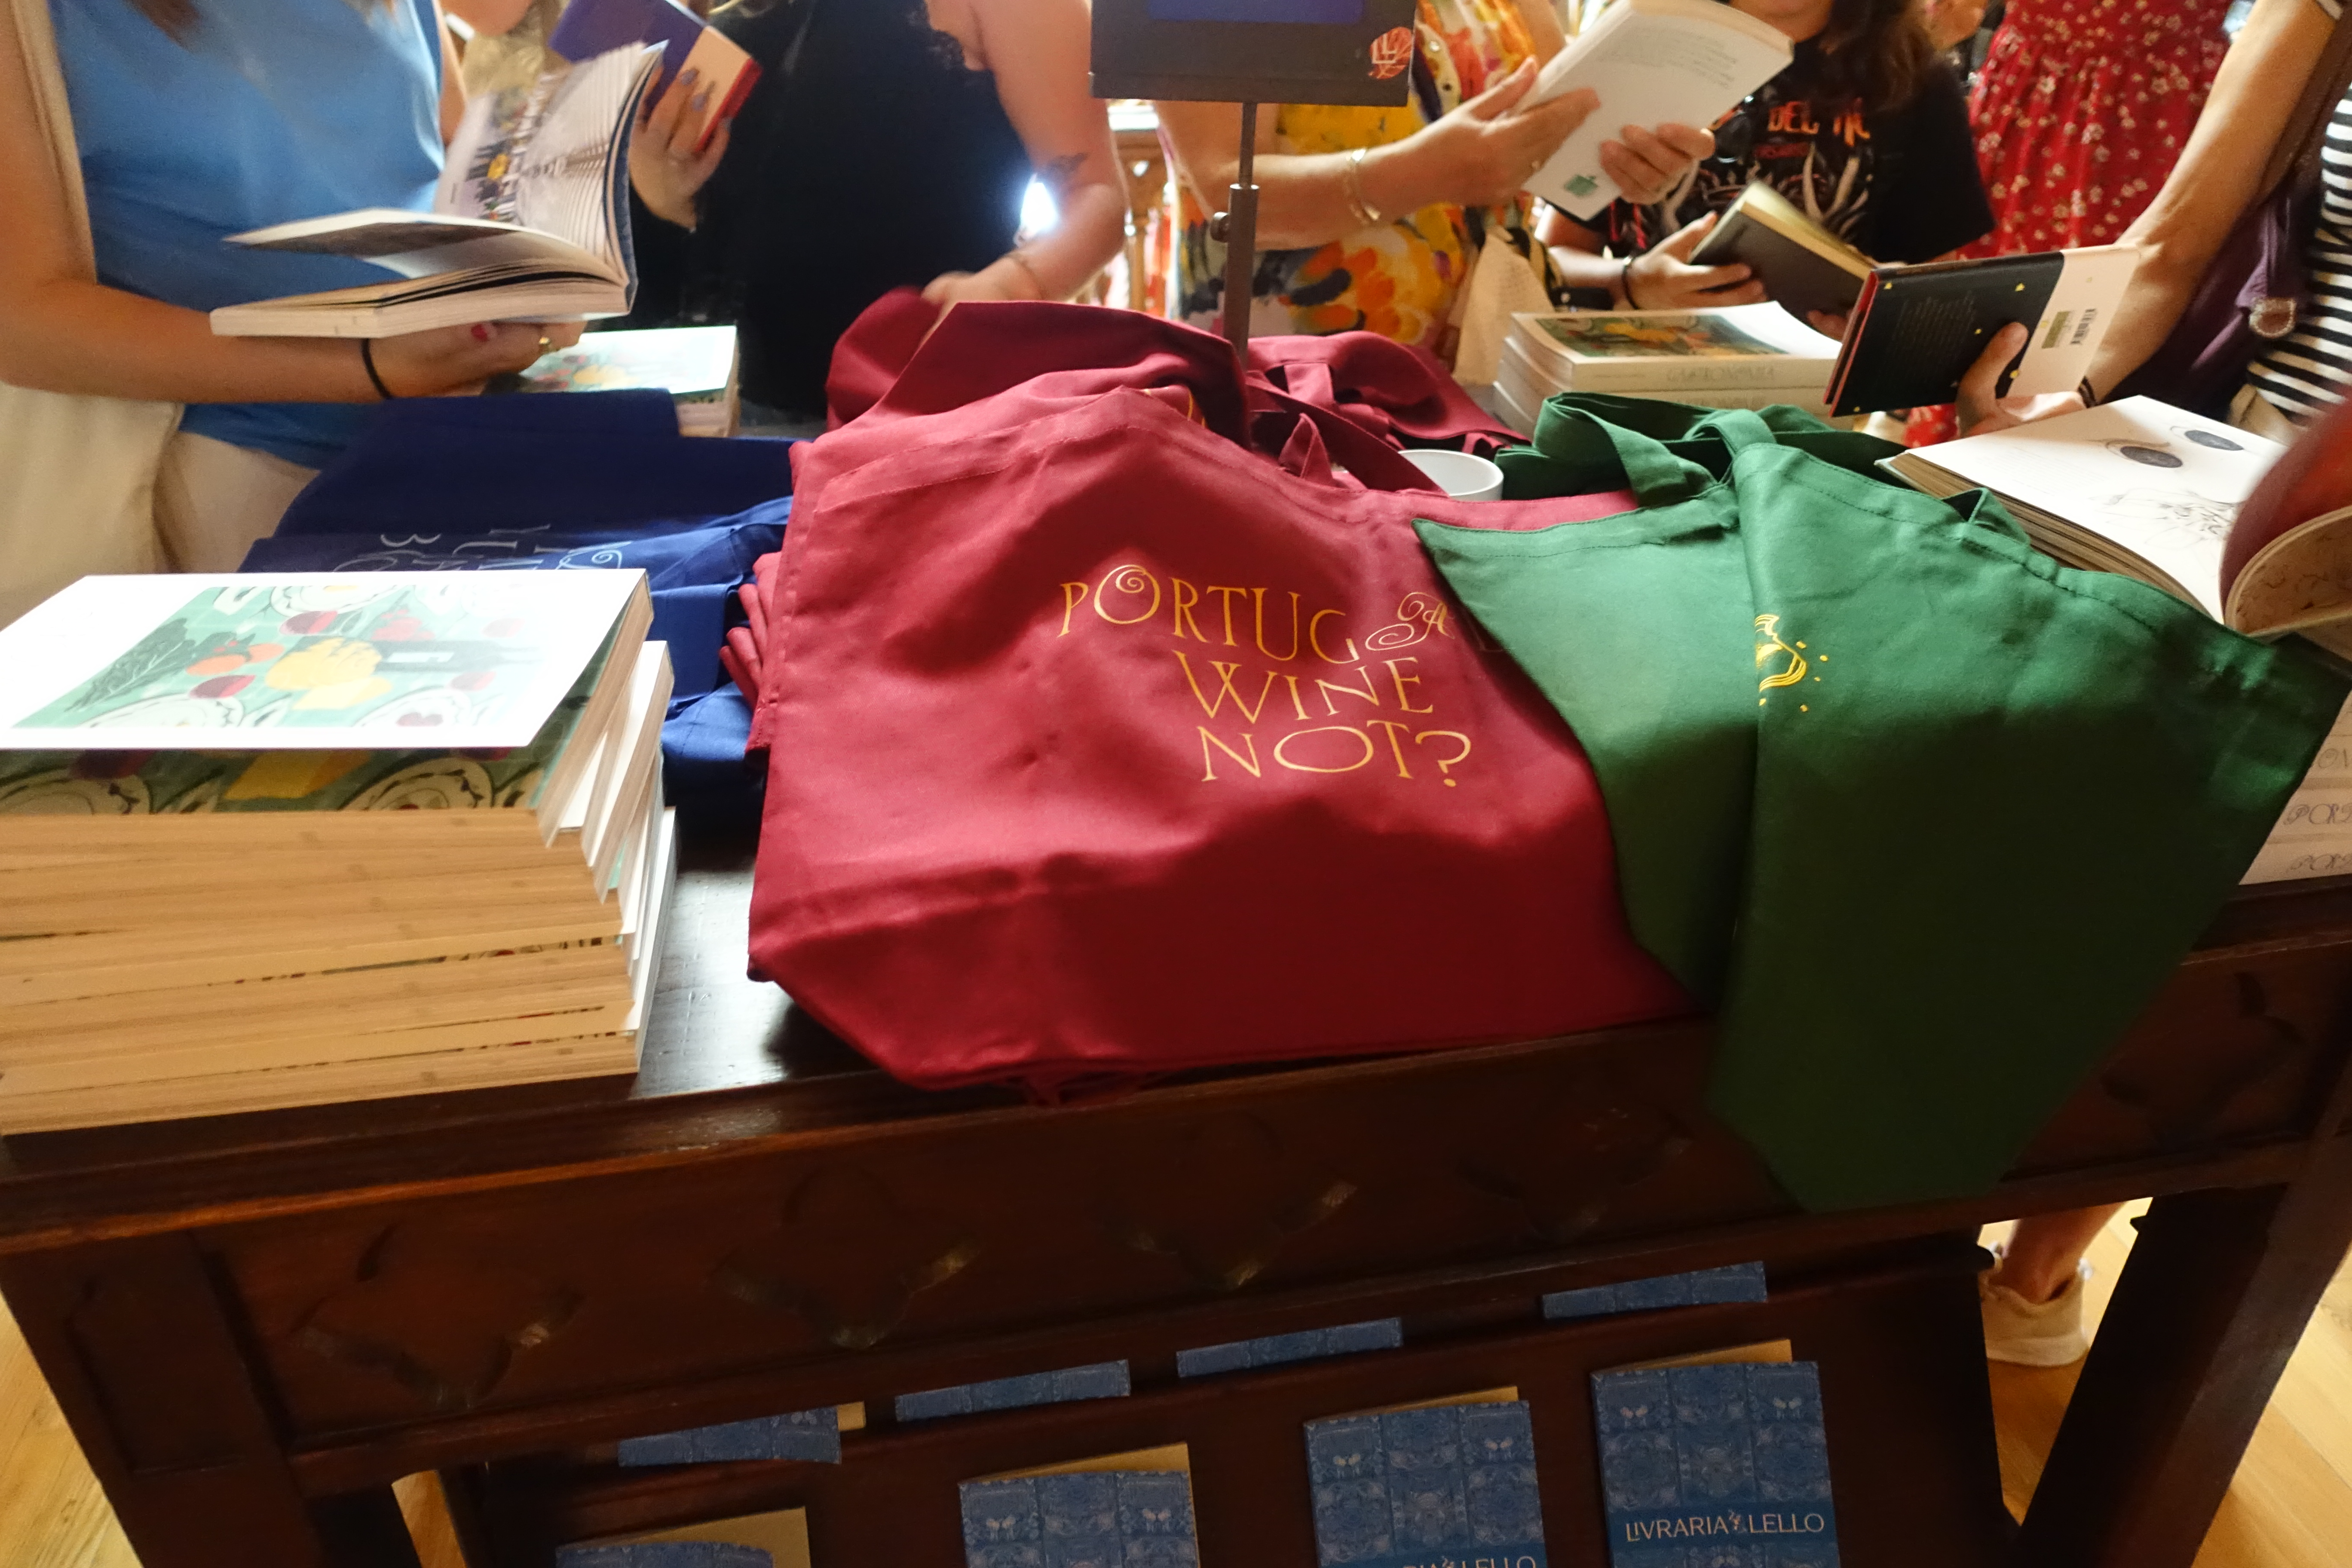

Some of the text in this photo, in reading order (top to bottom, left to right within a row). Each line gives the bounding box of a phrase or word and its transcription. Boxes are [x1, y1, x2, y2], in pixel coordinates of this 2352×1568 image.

[1171, 650, 1433, 724] WINE
[1197, 719, 1471, 787] NOT?
[1626, 1513, 1825, 1543] LIVRARIA LELLO
